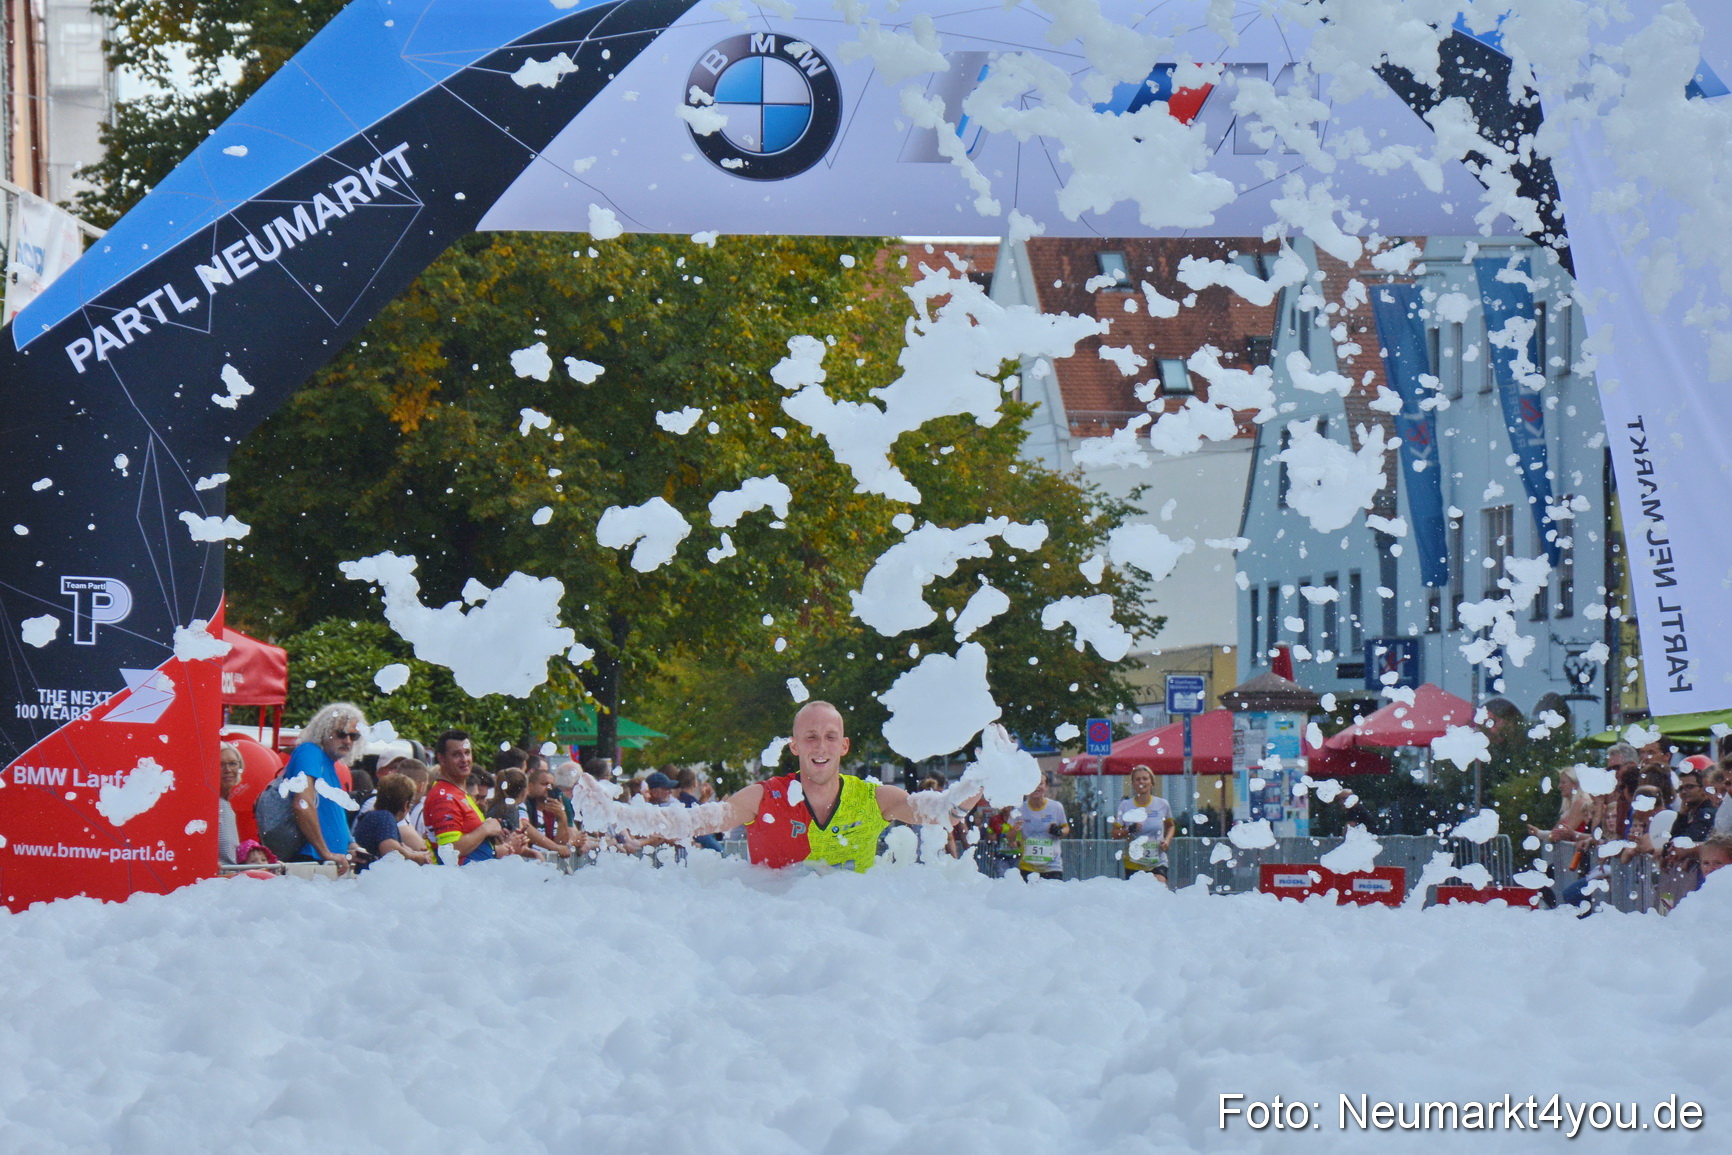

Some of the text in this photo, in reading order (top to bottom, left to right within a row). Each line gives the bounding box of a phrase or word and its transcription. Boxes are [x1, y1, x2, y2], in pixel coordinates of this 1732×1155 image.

[700, 34, 828, 78] BMW
[65, 141, 414, 373] PARTL NEUMARKT
[65, 581, 87, 589] Team
[37, 689, 113, 706] THE NEXT
[15, 704, 93, 721] 100 YEARS
[1089, 743, 1110, 753] TAXI
[13, 766, 67, 786] BMW
[12, 842, 176, 863] www.bmw-partl.de
[1032, 846, 1043, 855] 51
